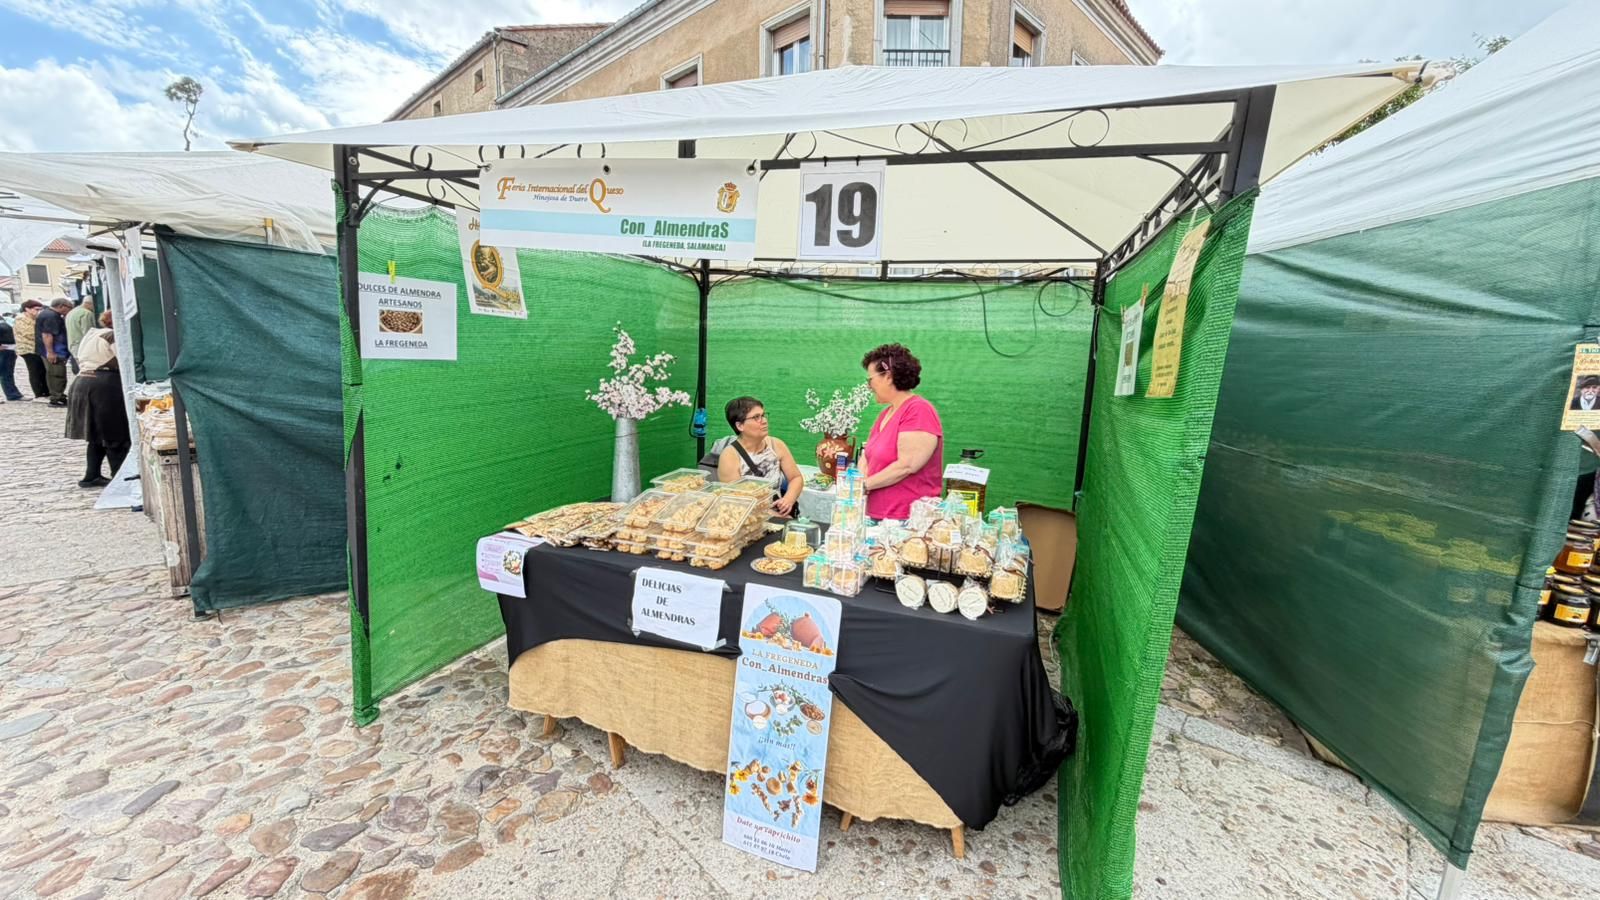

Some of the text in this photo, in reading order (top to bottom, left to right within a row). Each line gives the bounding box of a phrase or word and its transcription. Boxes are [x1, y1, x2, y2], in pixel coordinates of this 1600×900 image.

[497, 176, 624, 213] Feria Internacional del Queso
[533, 194, 560, 203] Hinojosa
[569, 195, 588, 203] Duero
[805, 181, 878, 249] 19
[359, 283, 442, 298] DULCES DE ALMENDRA
[378, 298, 422, 309] ARTESANOS
[374, 339, 428, 348] LA FREGENEDA
[642, 578, 682, 593] DELICIAS
[656, 596, 669, 606] DE
[641, 607, 696, 626] ALMENDRAS
[752, 649, 818, 669] LA FREGENEDA
